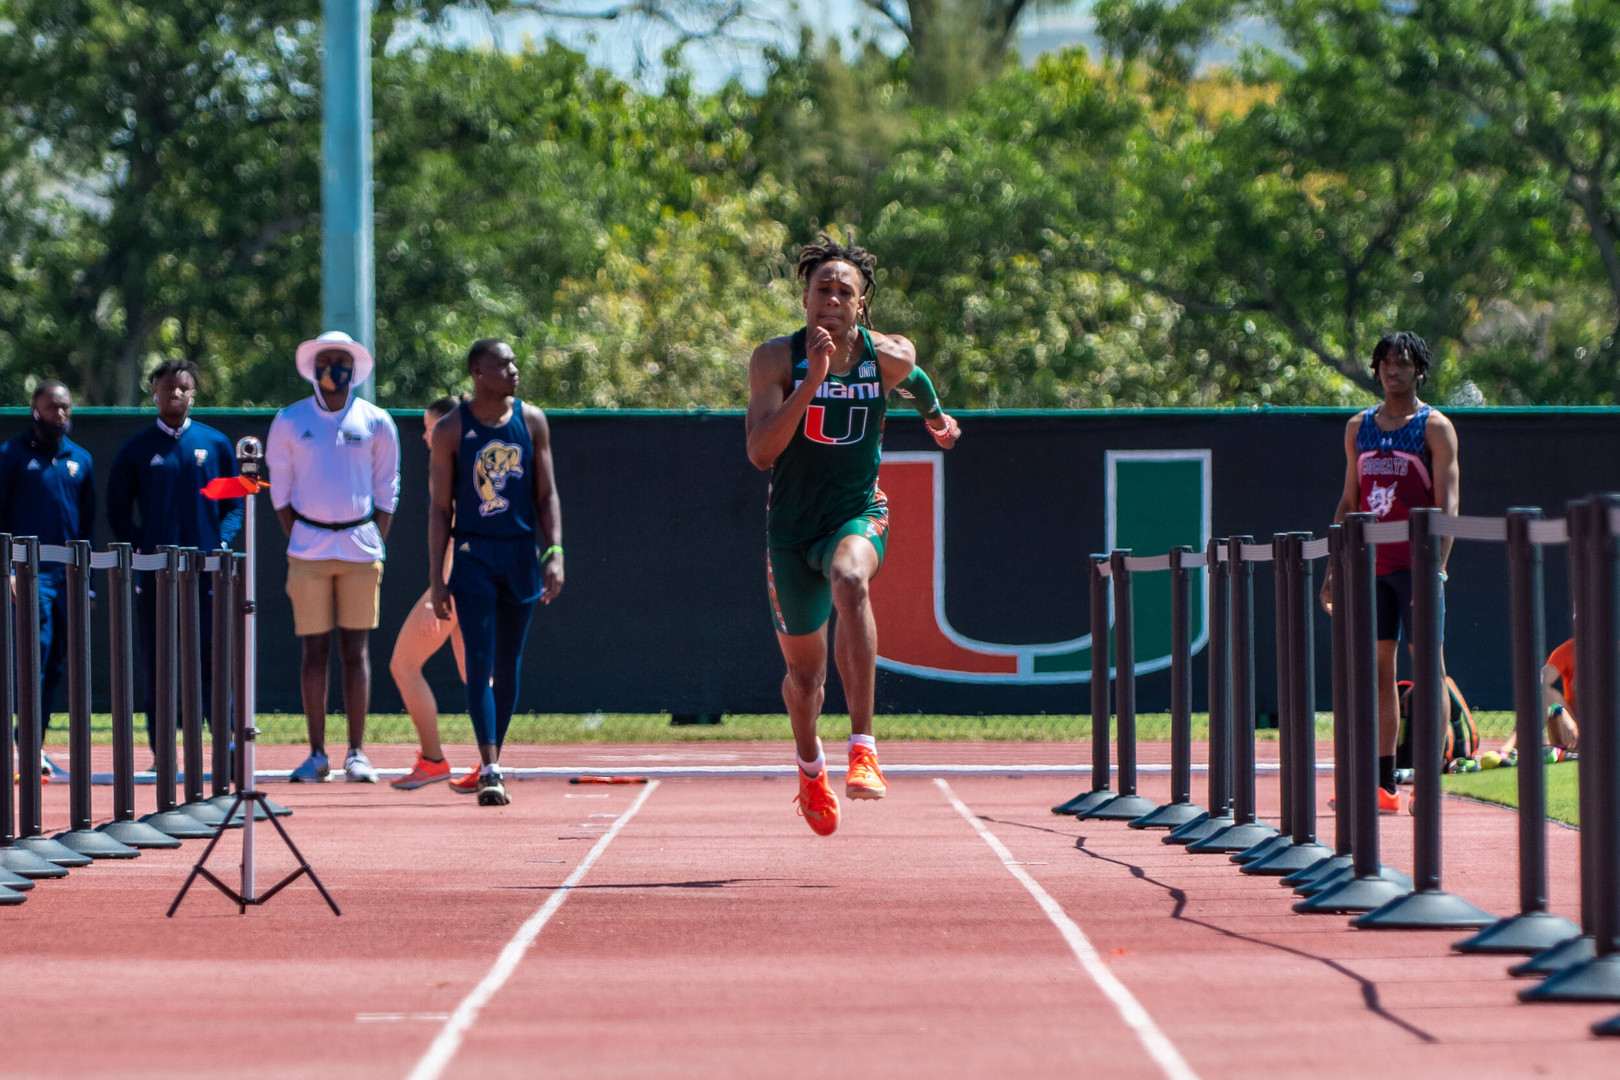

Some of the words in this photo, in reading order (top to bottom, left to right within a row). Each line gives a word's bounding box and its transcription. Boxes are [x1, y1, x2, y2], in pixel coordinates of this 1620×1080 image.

[858, 365, 877, 378] UNITY
[804, 404, 868, 445] U
[1362, 457, 1409, 476] BOBCATS
[876, 449, 1212, 685] U
